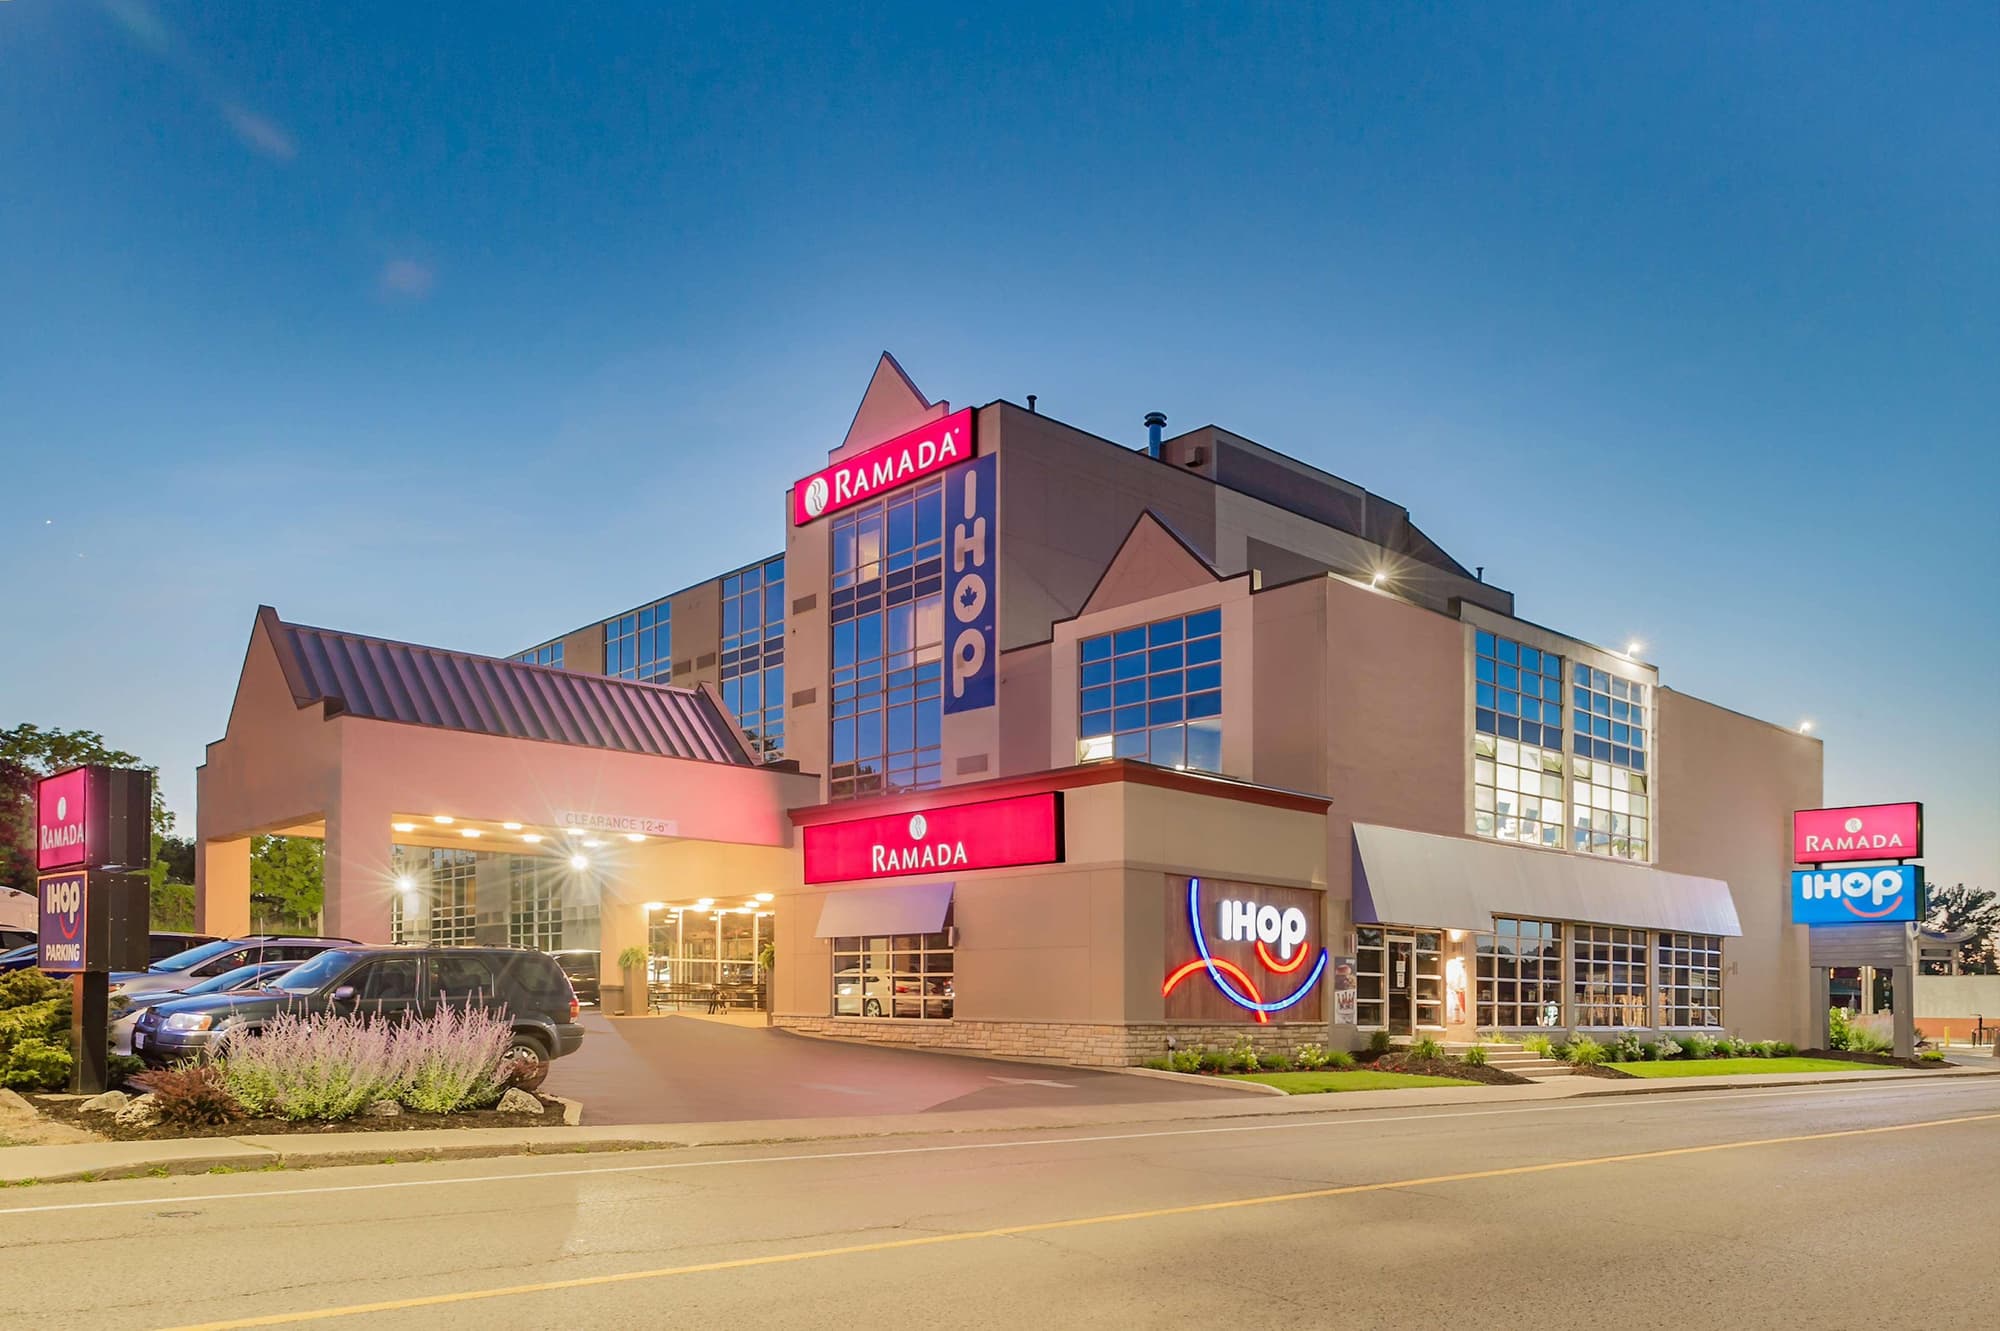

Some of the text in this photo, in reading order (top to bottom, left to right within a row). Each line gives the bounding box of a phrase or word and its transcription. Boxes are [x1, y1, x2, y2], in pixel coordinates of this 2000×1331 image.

[834, 431, 958, 503] RAMADA
[953, 470, 987, 698] IHOP
[41, 823, 85, 850] RAMADA
[566, 812, 638, 830] CLEARANCE
[872, 841, 968, 873] RAMADA
[1805, 833, 1903, 852] RAMADA
[46, 880, 81, 924] IHOP
[1802, 870, 1903, 906] IHOP
[1221, 899, 1306, 959] IHOP
[45, 943, 80, 962] PARKING
